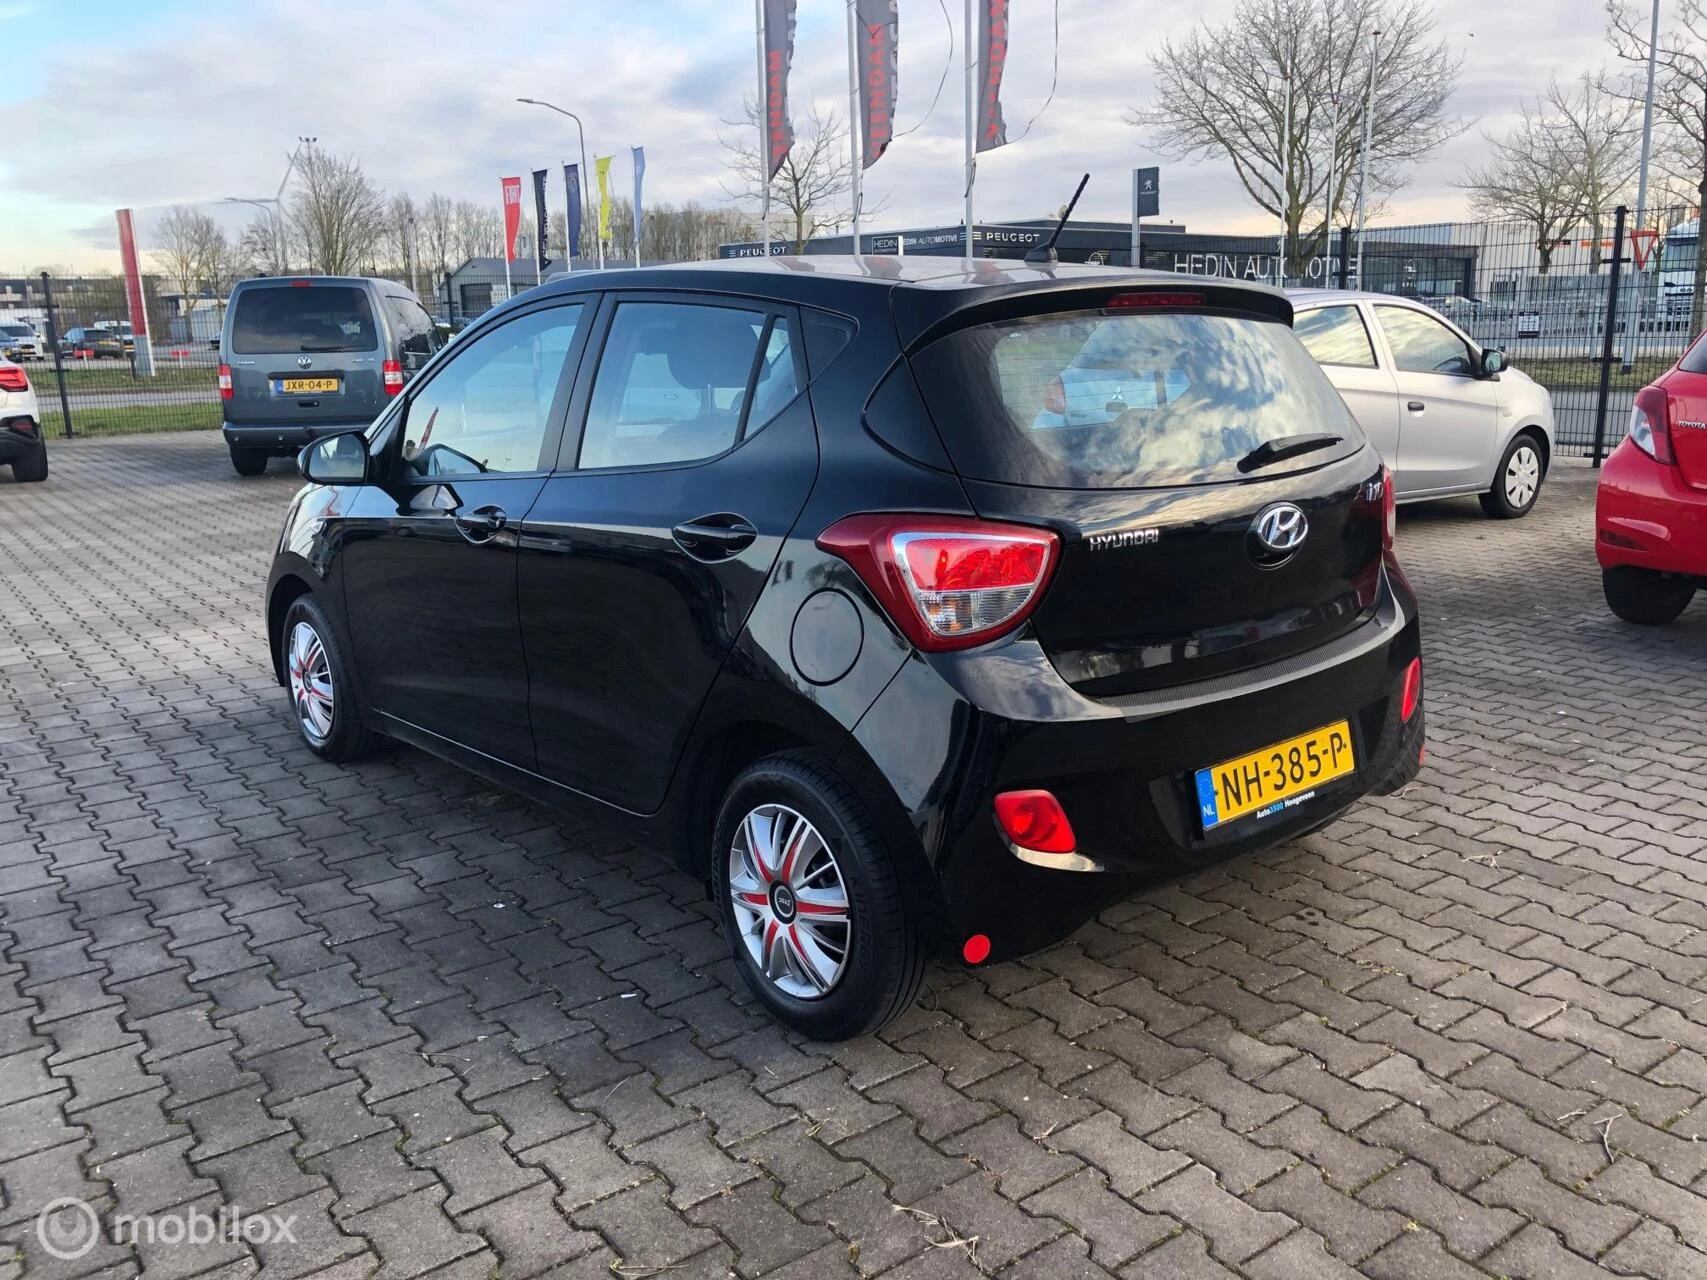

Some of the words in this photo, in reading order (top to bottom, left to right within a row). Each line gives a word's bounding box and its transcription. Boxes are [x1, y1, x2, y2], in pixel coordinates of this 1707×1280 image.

[986, 232, 1040, 243] PEUGEOT
[873, 239, 898, 248] HEDIN
[286, 380, 333, 391] JXR-04-P
[1678, 420, 1706, 429] TOYOTA
[1089, 529, 1159, 551] HYUNDAI
[1221, 732, 1343, 811] NH-385-P
[1202, 802, 1216, 817] NL
